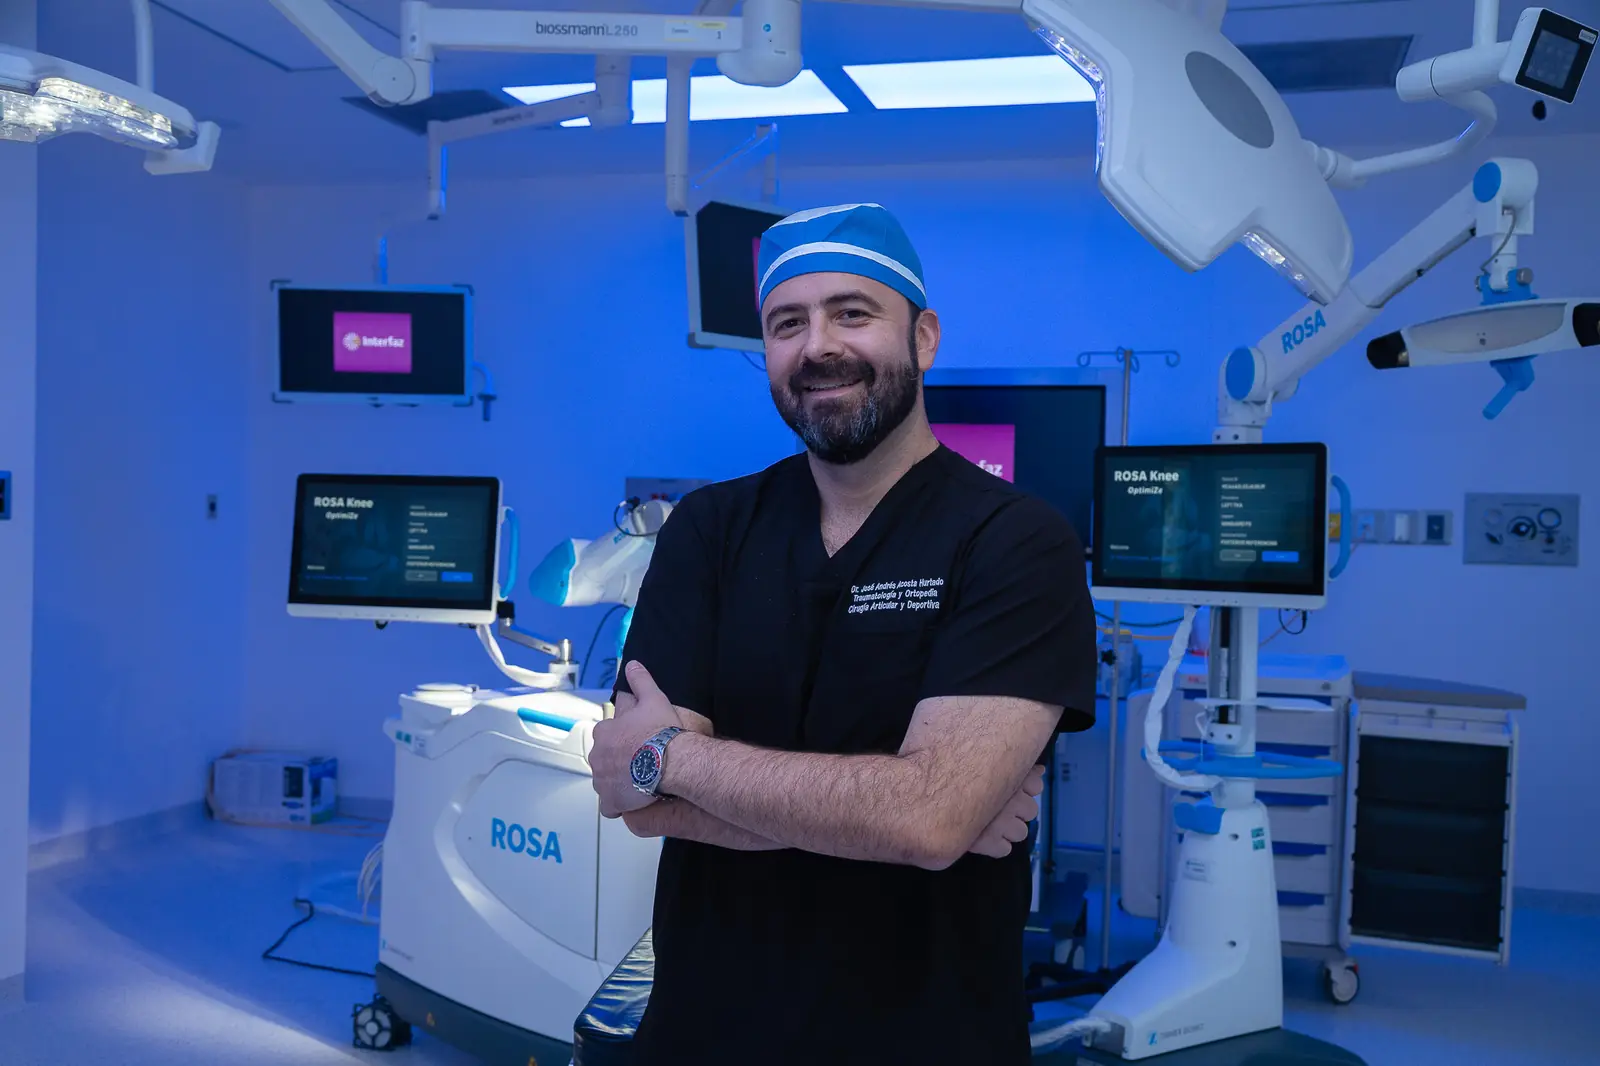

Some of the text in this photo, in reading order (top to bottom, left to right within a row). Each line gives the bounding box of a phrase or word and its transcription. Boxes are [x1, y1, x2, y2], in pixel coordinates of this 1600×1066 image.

[1282, 309, 1326, 354] ROSA
[362, 335, 405, 348] Interfaz
[1114, 470, 1180, 481] ROSA Knee
[1127, 486, 1163, 496] OptimiZe
[314, 497, 374, 509] ROSA Knee
[875, 581, 896, 591] Andrés
[896, 579, 918, 589] Acosta
[919, 577, 944, 587] Hurtado
[853, 590, 897, 602] Traumatología
[897, 591, 903, 600] y
[869, 601, 899, 611] Articular
[899, 602, 905, 611] y
[907, 599, 940, 611] Deportiva
[491, 817, 563, 864] ROSA
